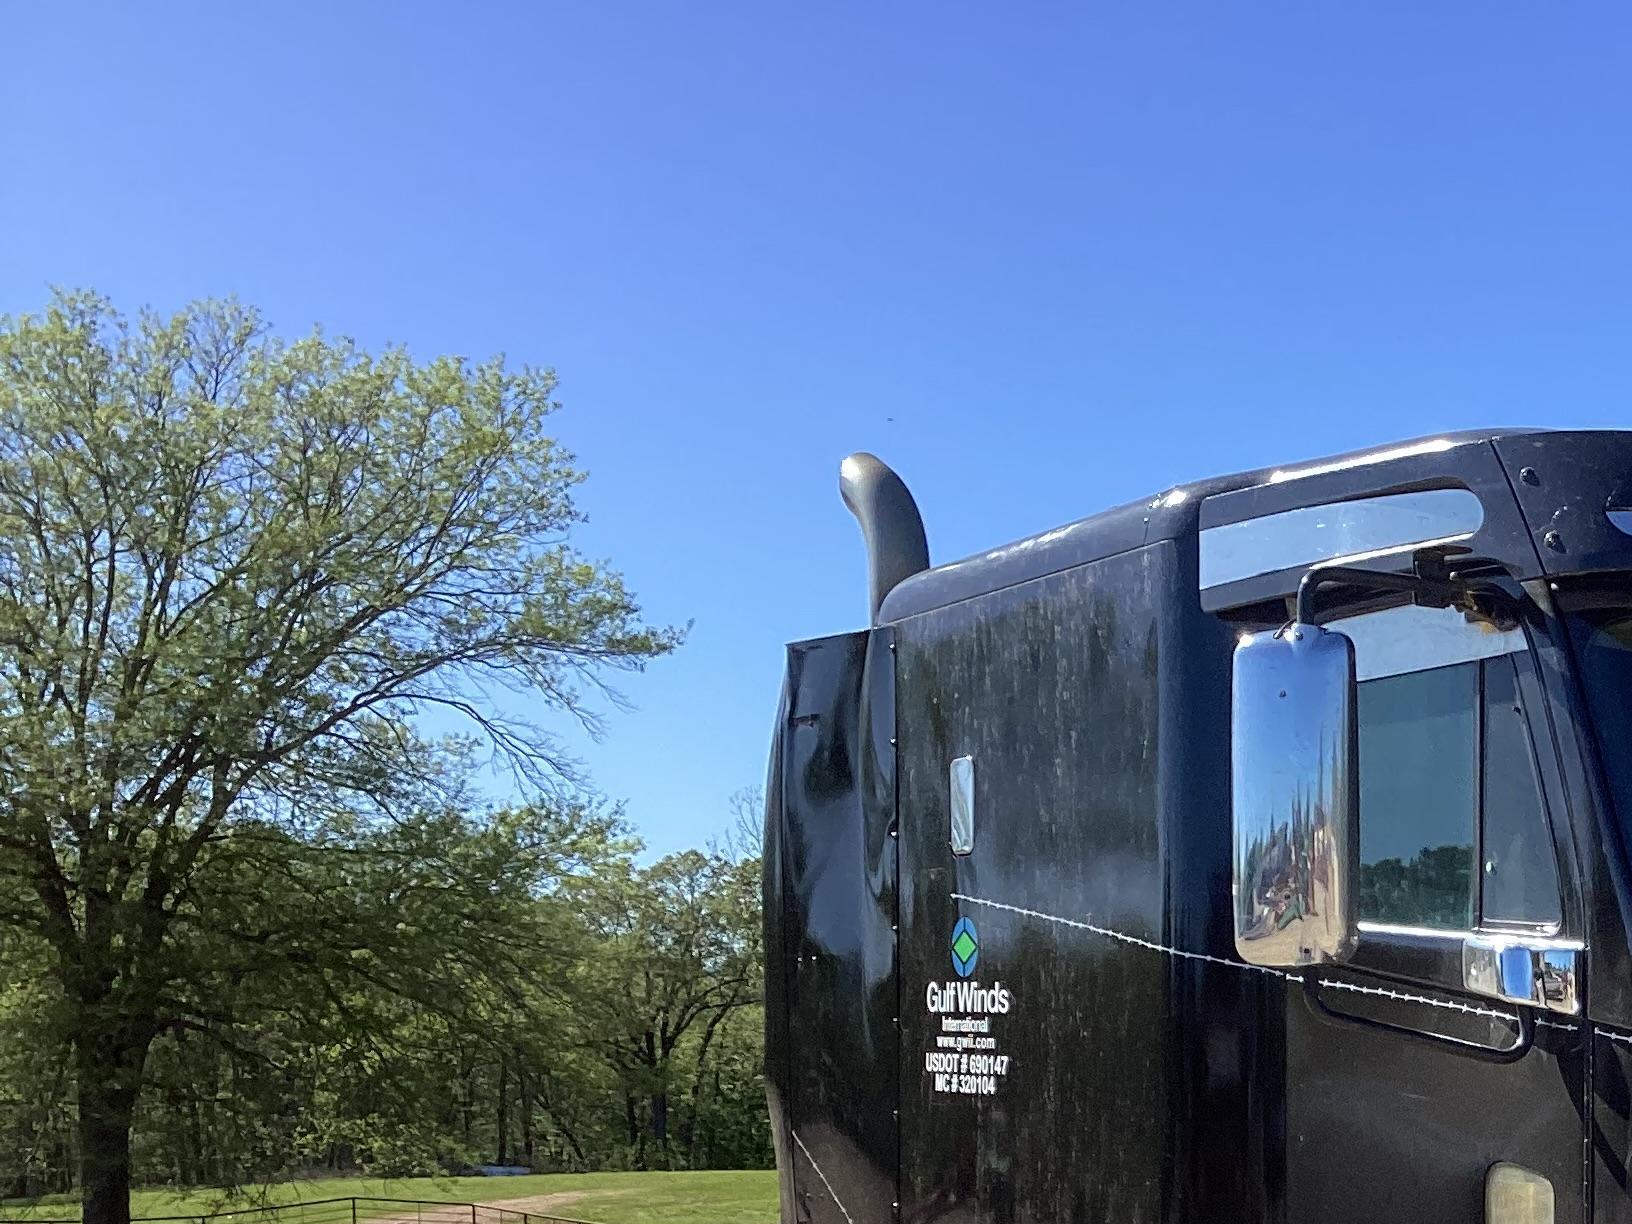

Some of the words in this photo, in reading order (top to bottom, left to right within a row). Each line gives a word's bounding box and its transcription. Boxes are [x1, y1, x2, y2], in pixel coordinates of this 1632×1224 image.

[927, 981, 956, 1013] Gulf
[956, 981, 1009, 1014] Winds
[942, 1016, 989, 1033] International
[925, 1052, 960, 1073] USDOT
[969, 1054, 1009, 1076] 690147
[934, 1073, 950, 1092] MC
[959, 1074, 996, 1095] 320104
